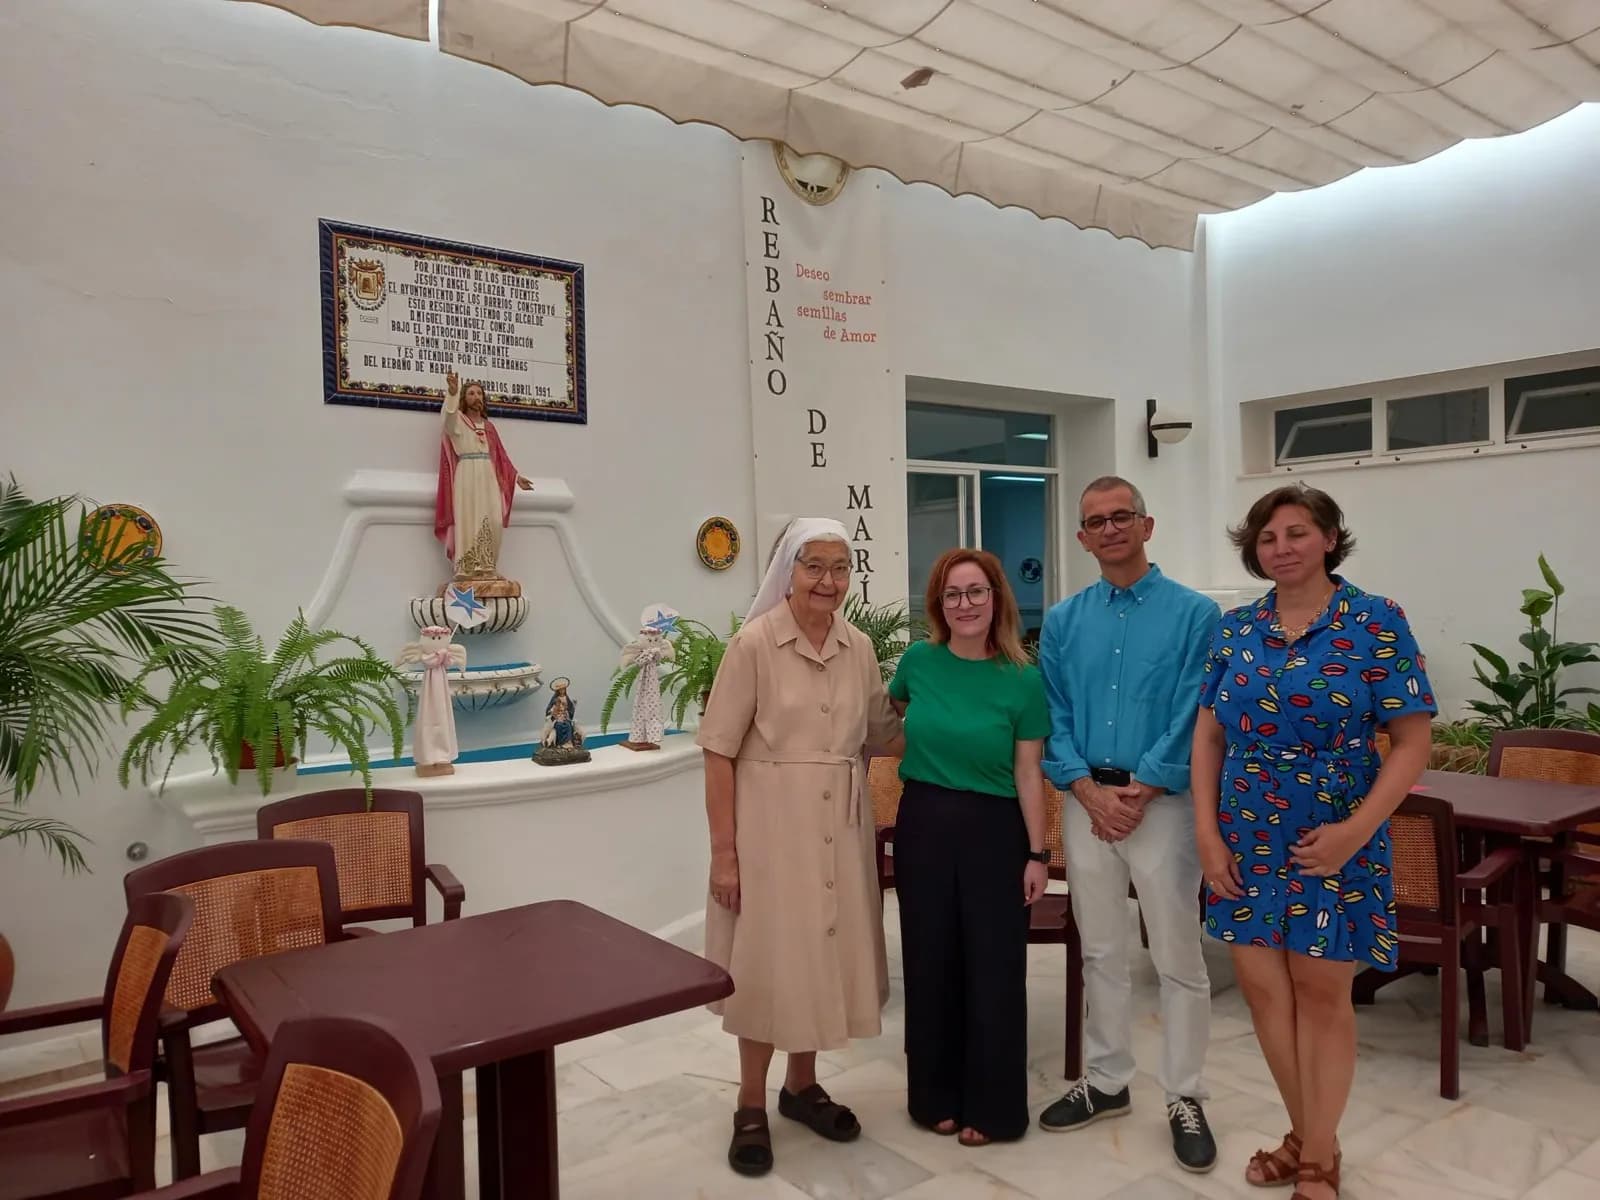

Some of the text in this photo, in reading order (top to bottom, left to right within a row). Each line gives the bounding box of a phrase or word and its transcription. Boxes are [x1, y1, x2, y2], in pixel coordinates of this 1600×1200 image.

[414, 260, 539, 290] POR INICIATIVA DE LOS HERMANOS
[796, 263, 830, 281] Deseo
[388, 281, 555, 316] EL AYUNTAMIENTO DE LOS BARRIOS CONSTRUYÓ
[440, 277, 445, 288] Y
[473, 282, 505, 297] SALAZAR
[510, 288, 540, 302] FUENTES
[823, 289, 872, 305] sembrar
[408, 297, 544, 327] ESTA RESIDENCIA SIENDO SU ALCALDE
[796, 305, 847, 322] semillas
[391, 320, 534, 349] BAJO EL PATROCINIO DE LA FUNDACIÓN
[490, 321, 515, 334] CONEJO
[823, 326, 877, 343] de Amor
[415, 336, 510, 358] RAMON DIAZ BUSTAMANTE
[364, 354, 378, 368] DEL
[415, 360, 425, 373] DE
[397, 347, 528, 371] Y ES ATENDIDA POR LAS HERMANAS
[511, 385, 532, 397] ABRIL
[760, 196, 874, 615] REBAÑO DE MARÍ
